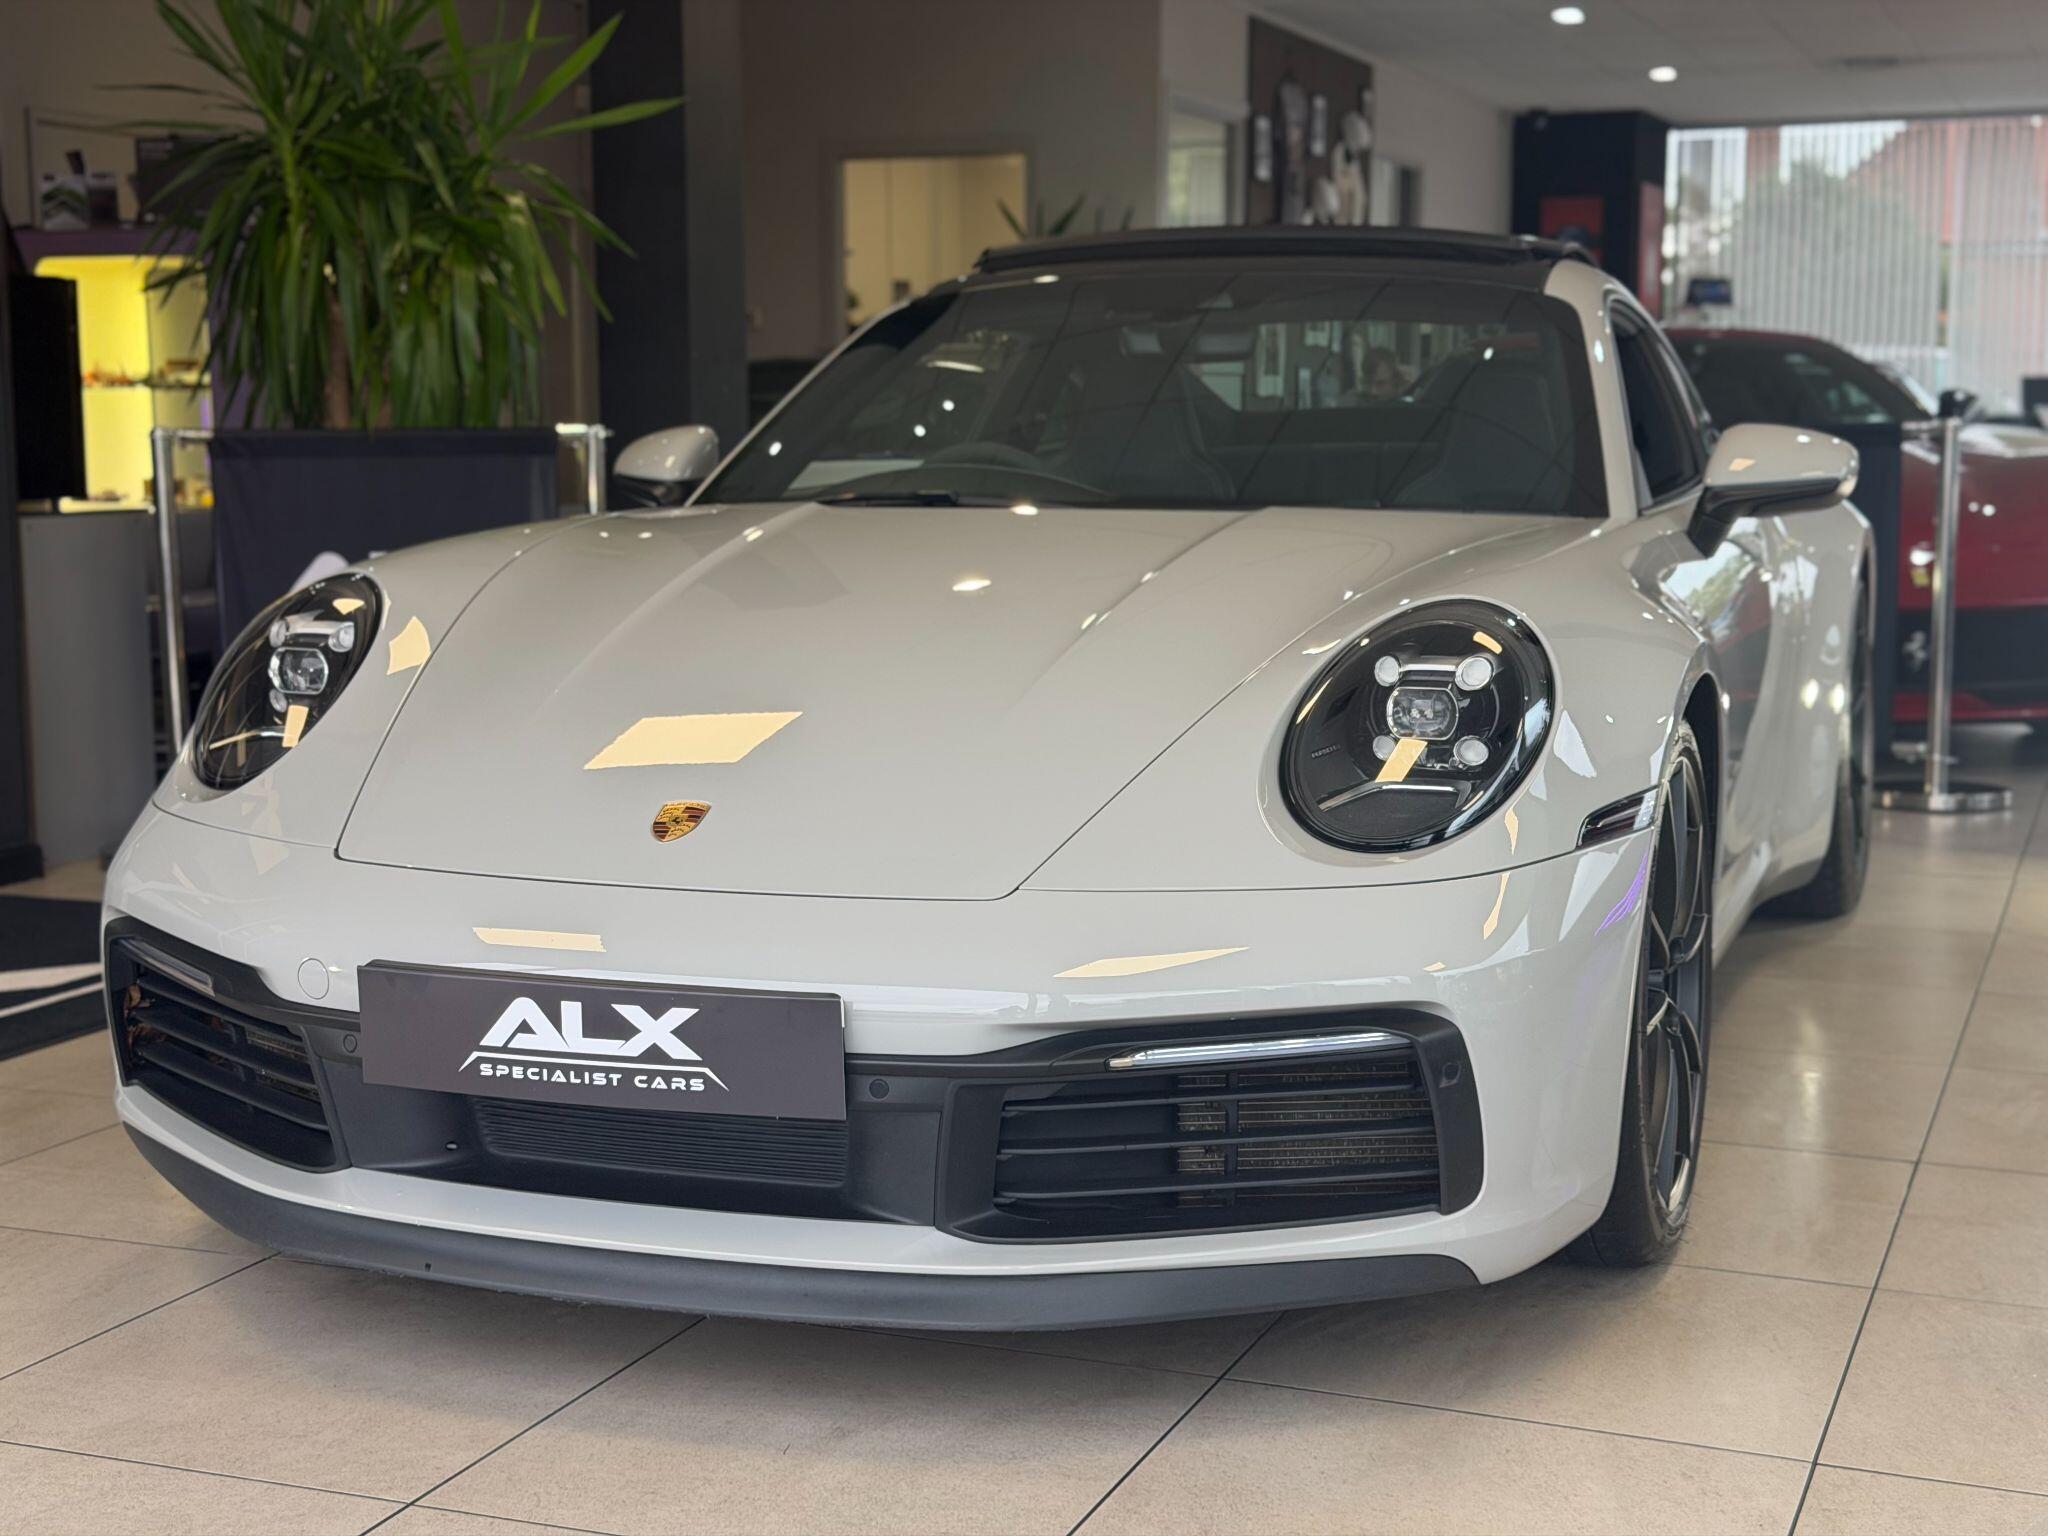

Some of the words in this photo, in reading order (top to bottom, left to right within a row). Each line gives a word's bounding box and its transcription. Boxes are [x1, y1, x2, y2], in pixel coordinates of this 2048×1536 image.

[479, 996, 703, 1061] ALX
[479, 1063, 623, 1087] SPECIALIST
[633, 1075, 705, 1092] CARS
